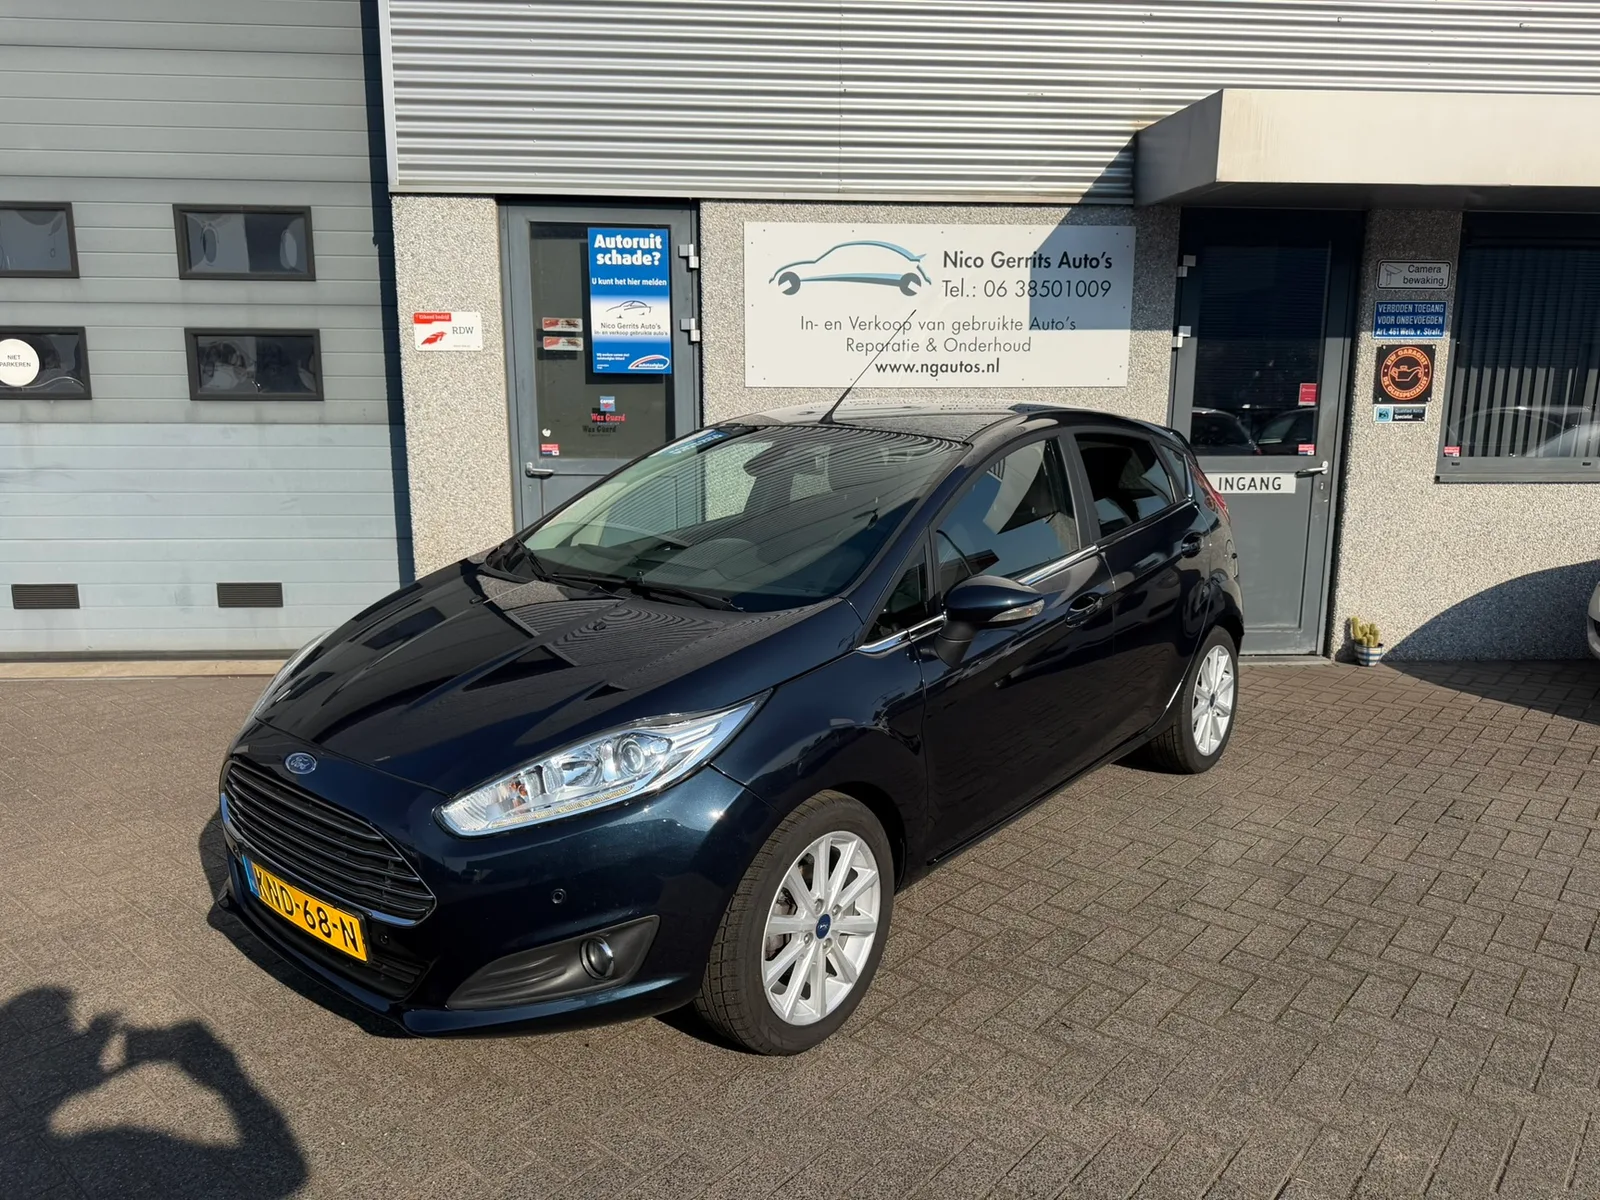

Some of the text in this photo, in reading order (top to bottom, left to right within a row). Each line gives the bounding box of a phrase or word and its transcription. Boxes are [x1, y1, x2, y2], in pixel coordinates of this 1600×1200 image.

[594, 233, 662, 249] Autoruit
[596, 250, 661, 265] schade?
[943, 250, 1113, 269] Nico Gerrits Auto's
[1408, 264, 1441, 273] Camera
[598, 277, 613, 285] kunt
[642, 278, 667, 286] melden
[942, 278, 1112, 298] Tel.: 06 38501009
[1403, 276, 1444, 286] bewaking
[1378, 304, 1444, 312] VERBODEN TOEGANG
[801, 315, 1076, 335] In- en Verkoop van gebruikte Auto's
[1378, 316, 1443, 324] VOOR ONBEVOEGDEN
[452, 326, 474, 334] RDW
[846, 336, 1032, 356] Reparatie & Onderhoud
[1386, 349, 1428, 365] UW GARAGIST
[875, 358, 1000, 377] www.ngautos.nl
[1383, 376, 1428, 398] DE OLIESPECIALIST
[605, 413, 626, 421] Guard
[1218, 477, 1282, 491] INGANG
[254, 867, 359, 952] KND-68-N
